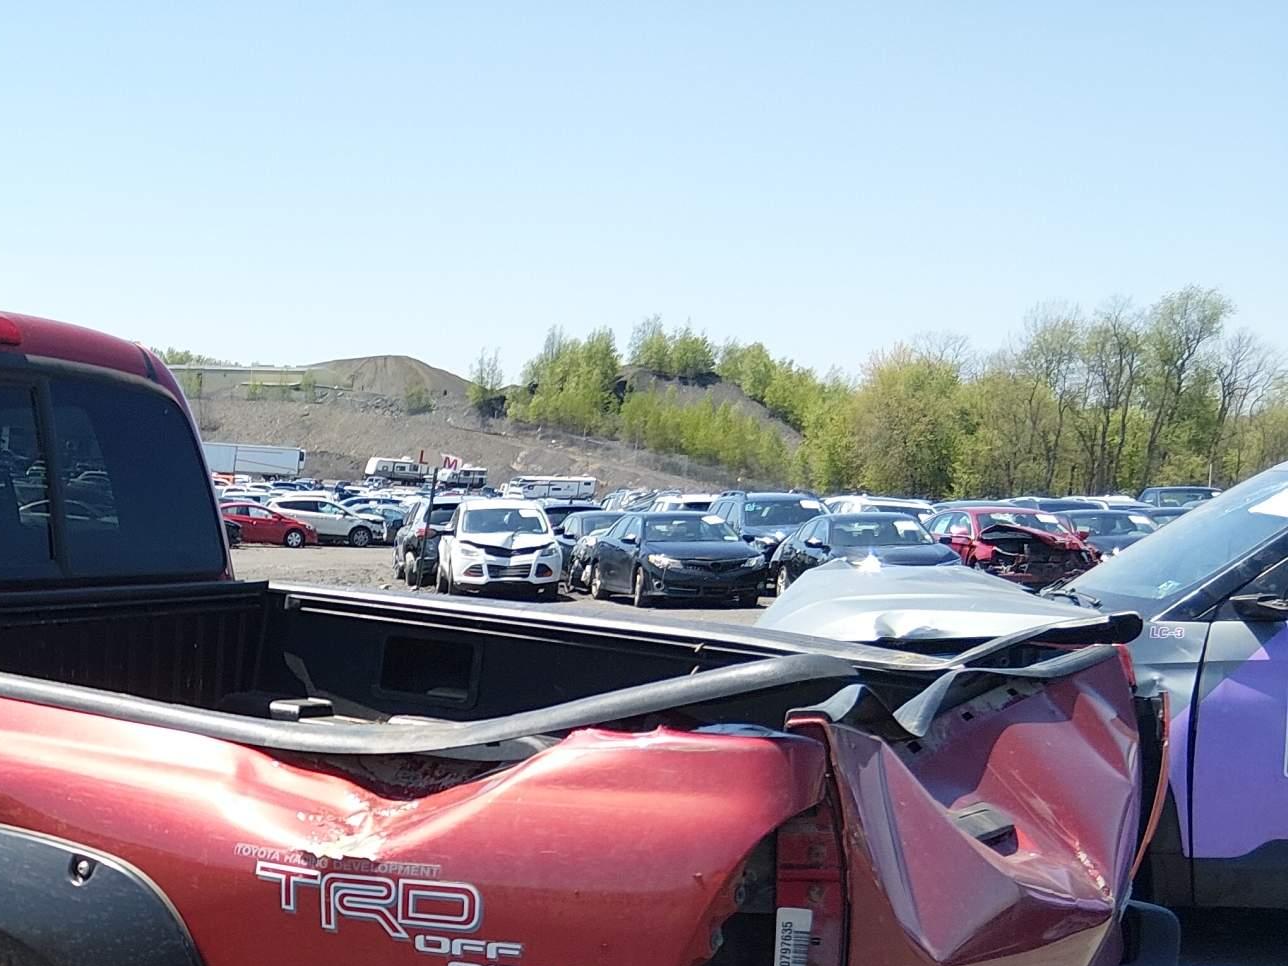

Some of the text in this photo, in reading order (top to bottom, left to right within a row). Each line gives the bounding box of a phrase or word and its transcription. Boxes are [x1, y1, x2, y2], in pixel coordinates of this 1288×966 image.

[443, 457, 458, 471] M
[237, 843, 280, 862] TOYOTA
[333, 858, 440, 880] DEVELOPMENT
[255, 860, 484, 940] TRD
[414, 934, 523, 960] OFF
